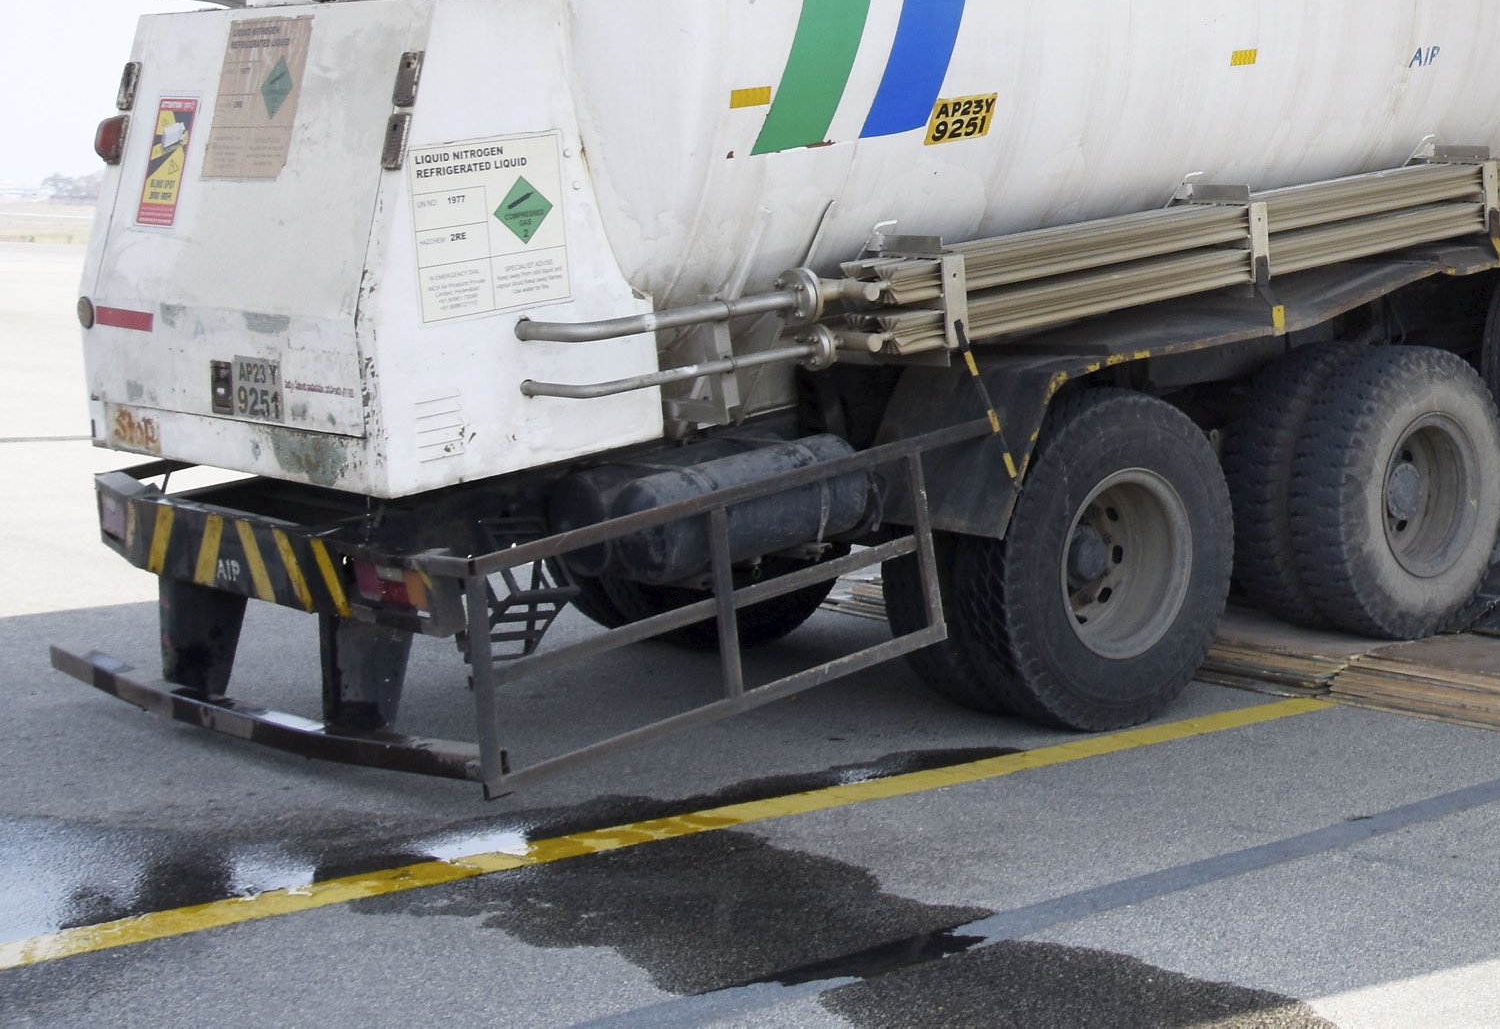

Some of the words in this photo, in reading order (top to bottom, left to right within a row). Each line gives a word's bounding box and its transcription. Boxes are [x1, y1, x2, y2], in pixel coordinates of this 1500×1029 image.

[936, 98, 996, 119] AP23Y
[932, 116, 986, 142] 9251
[415, 153, 450, 165] LIQUID
[453, 146, 504, 161] NITROGEN
[416, 162, 492, 179] REFRIGERATED
[494, 157, 528, 170] LIQUID
[447, 195, 466, 205] 1977
[504, 209, 545, 221] COMPRESSED
[450, 232, 467, 242] 2RE
[523, 229, 530, 238] 2
[238, 386, 280, 419] 9251
